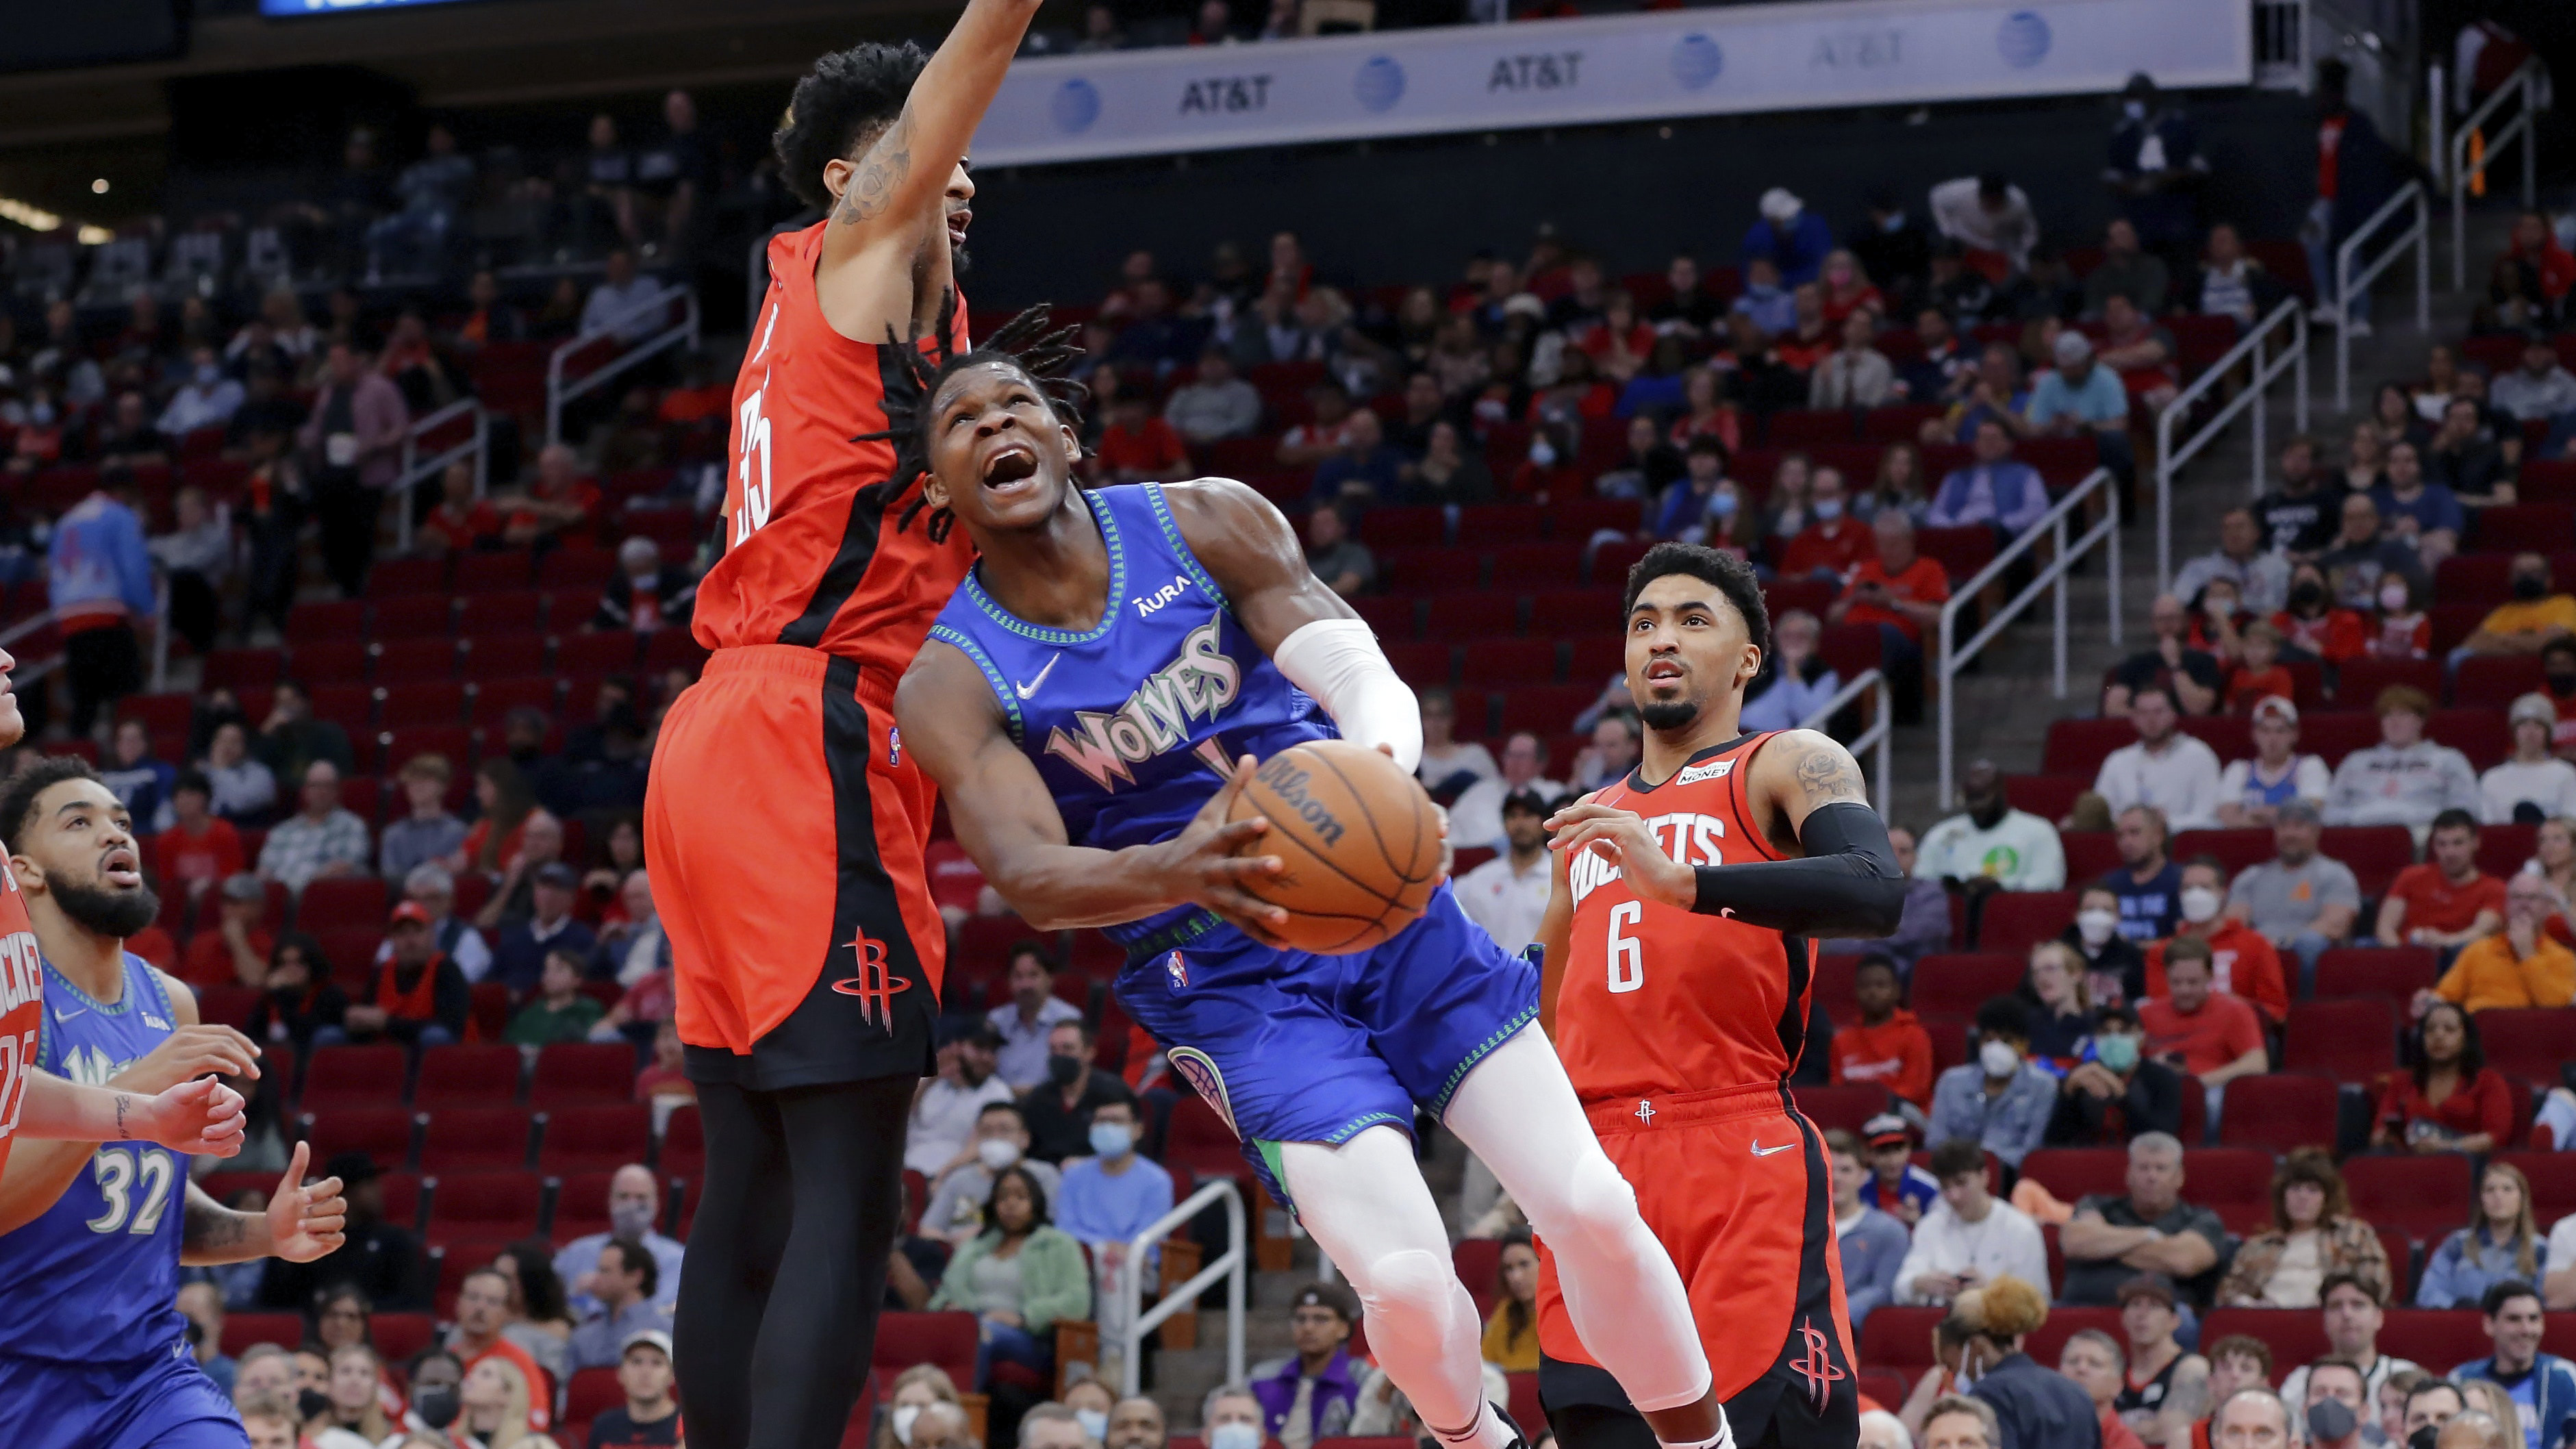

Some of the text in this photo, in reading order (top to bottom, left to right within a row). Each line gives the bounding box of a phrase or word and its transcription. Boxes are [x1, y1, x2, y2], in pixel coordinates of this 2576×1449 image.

[1179, 75, 1272, 116] AT&T
[1487, 51, 1583, 94] AT&T
[1044, 608, 1240, 794] WOLVES
[1257, 755, 1345, 848] Wilson
[1680, 768, 1726, 783] MONEY
[1607, 900, 1643, 994] 6
[86, 1147, 175, 1235] 32
